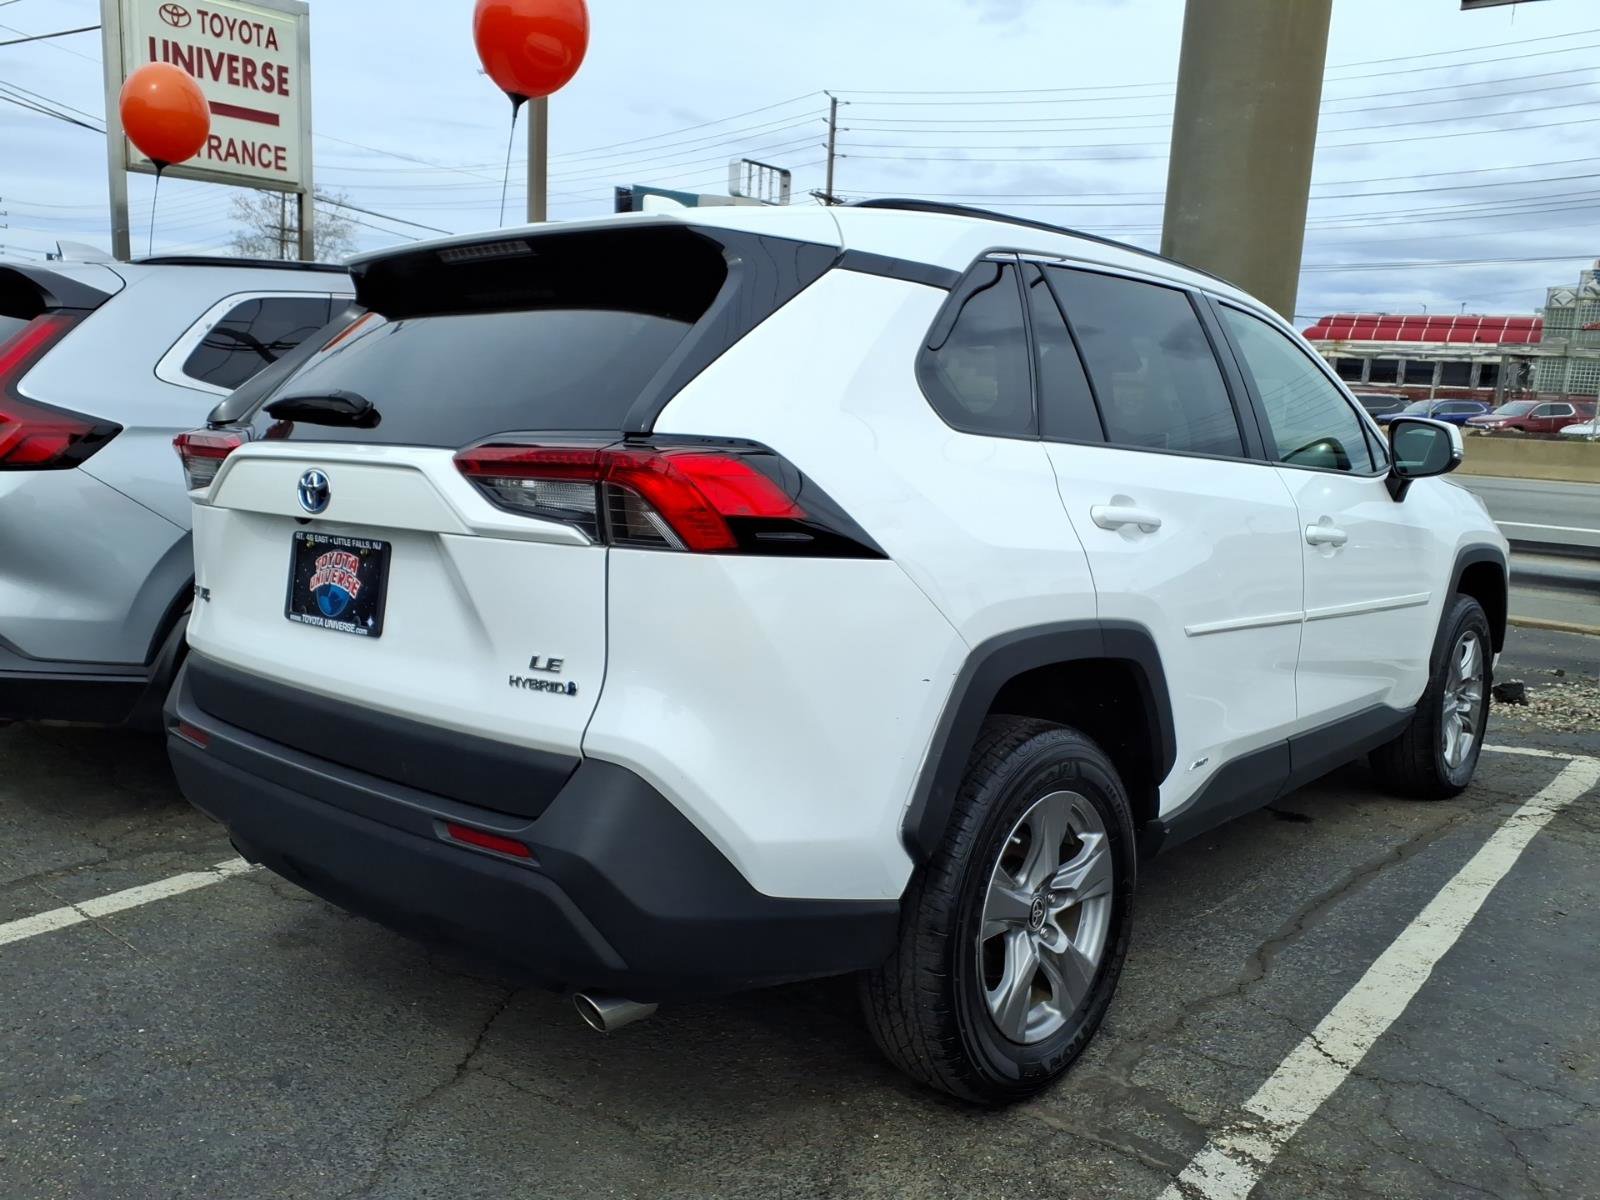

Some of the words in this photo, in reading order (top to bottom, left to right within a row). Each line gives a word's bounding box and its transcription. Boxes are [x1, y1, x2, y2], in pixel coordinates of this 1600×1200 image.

[197, 9, 279, 51] TOYOTA
[148, 36, 290, 97] UNIVERSE
[196, 134, 288, 171] RANCE
[315, 534, 328, 543] EAST
[333, 537, 351, 547] LITTLE
[372, 542, 382, 551] NJ
[315, 551, 360, 576] TOYOTA
[309, 567, 361, 599] UNIVERSE
[529, 655, 564, 673] LE
[509, 675, 564, 694] HYBRID
